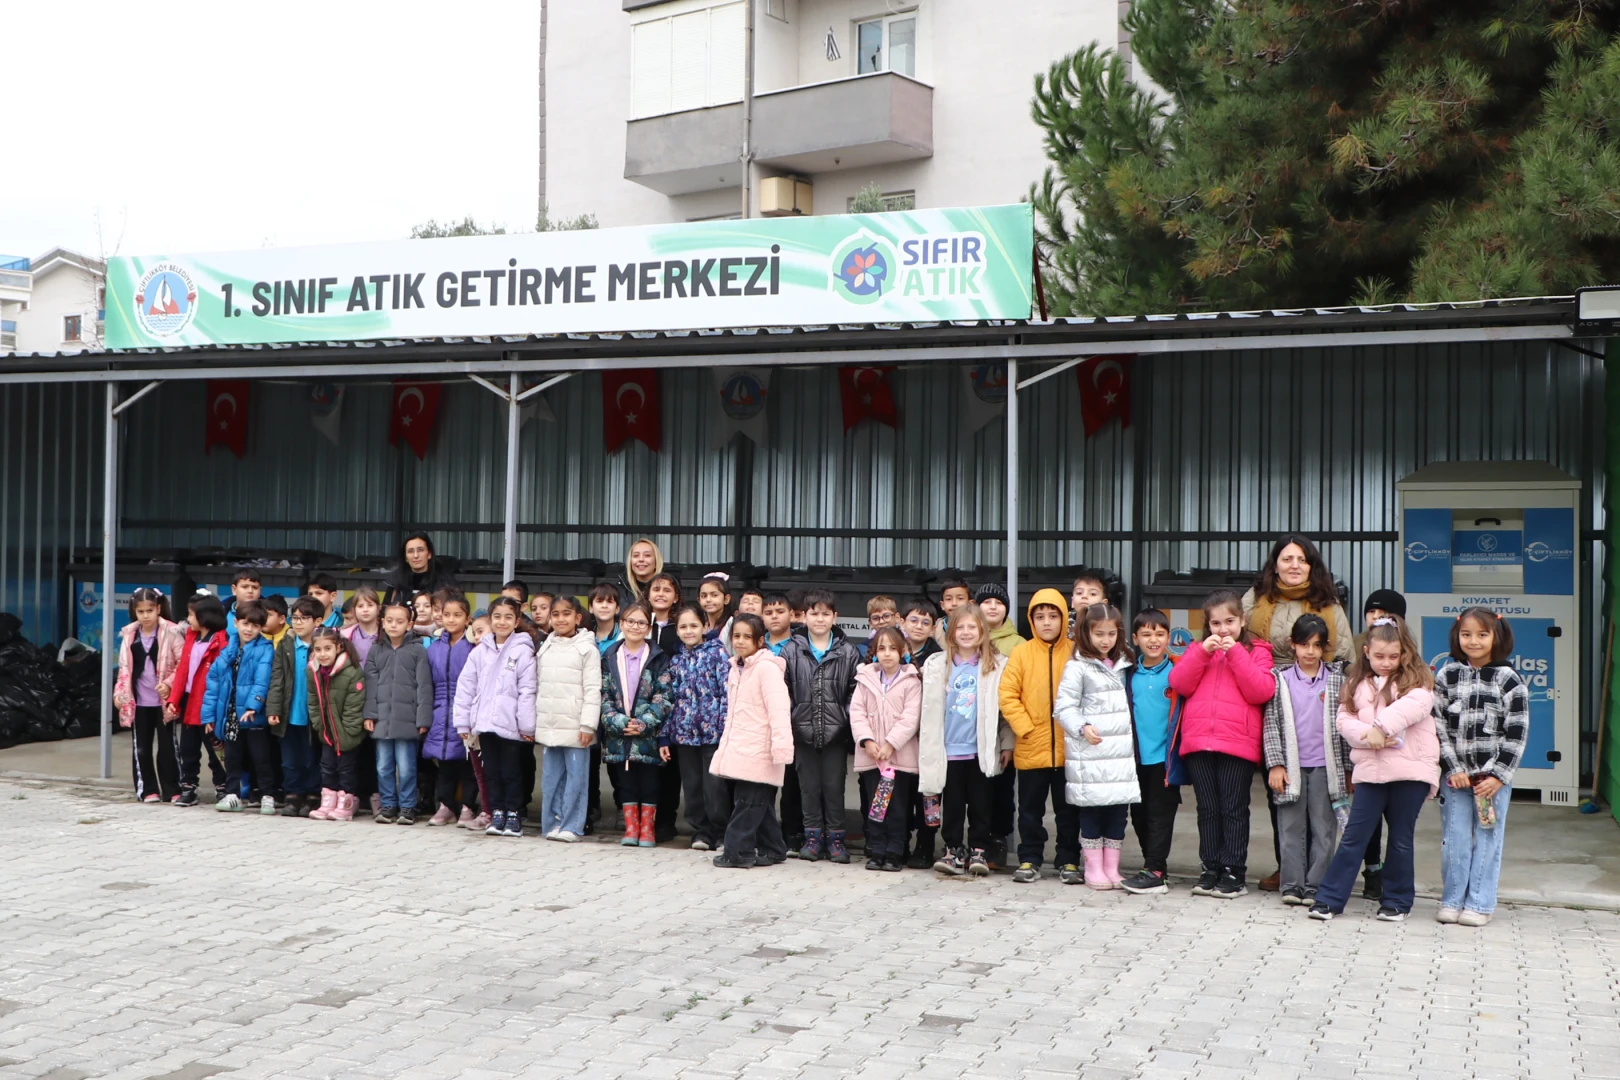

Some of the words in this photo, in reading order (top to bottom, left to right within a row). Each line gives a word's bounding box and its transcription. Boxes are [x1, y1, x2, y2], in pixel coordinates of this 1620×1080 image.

[902, 235, 982, 266] SIFIR
[139, 264, 168, 293] ÇİFTLİKKÖY
[169, 264, 195, 291] BELEDİYESİ
[221, 283, 242, 317] 1.
[252, 276, 338, 317] SINIF
[346, 273, 425, 312] ATIK
[436, 257, 596, 308] GETİRME
[608, 243, 780, 302] MERKEZİ
[903, 264, 982, 296] ATIK
[1443, 605, 1467, 613] BAĞ
[1491, 606, 1531, 614] UTUSU
[1509, 654, 1548, 674] laş
[1520, 674, 1548, 687] ya
